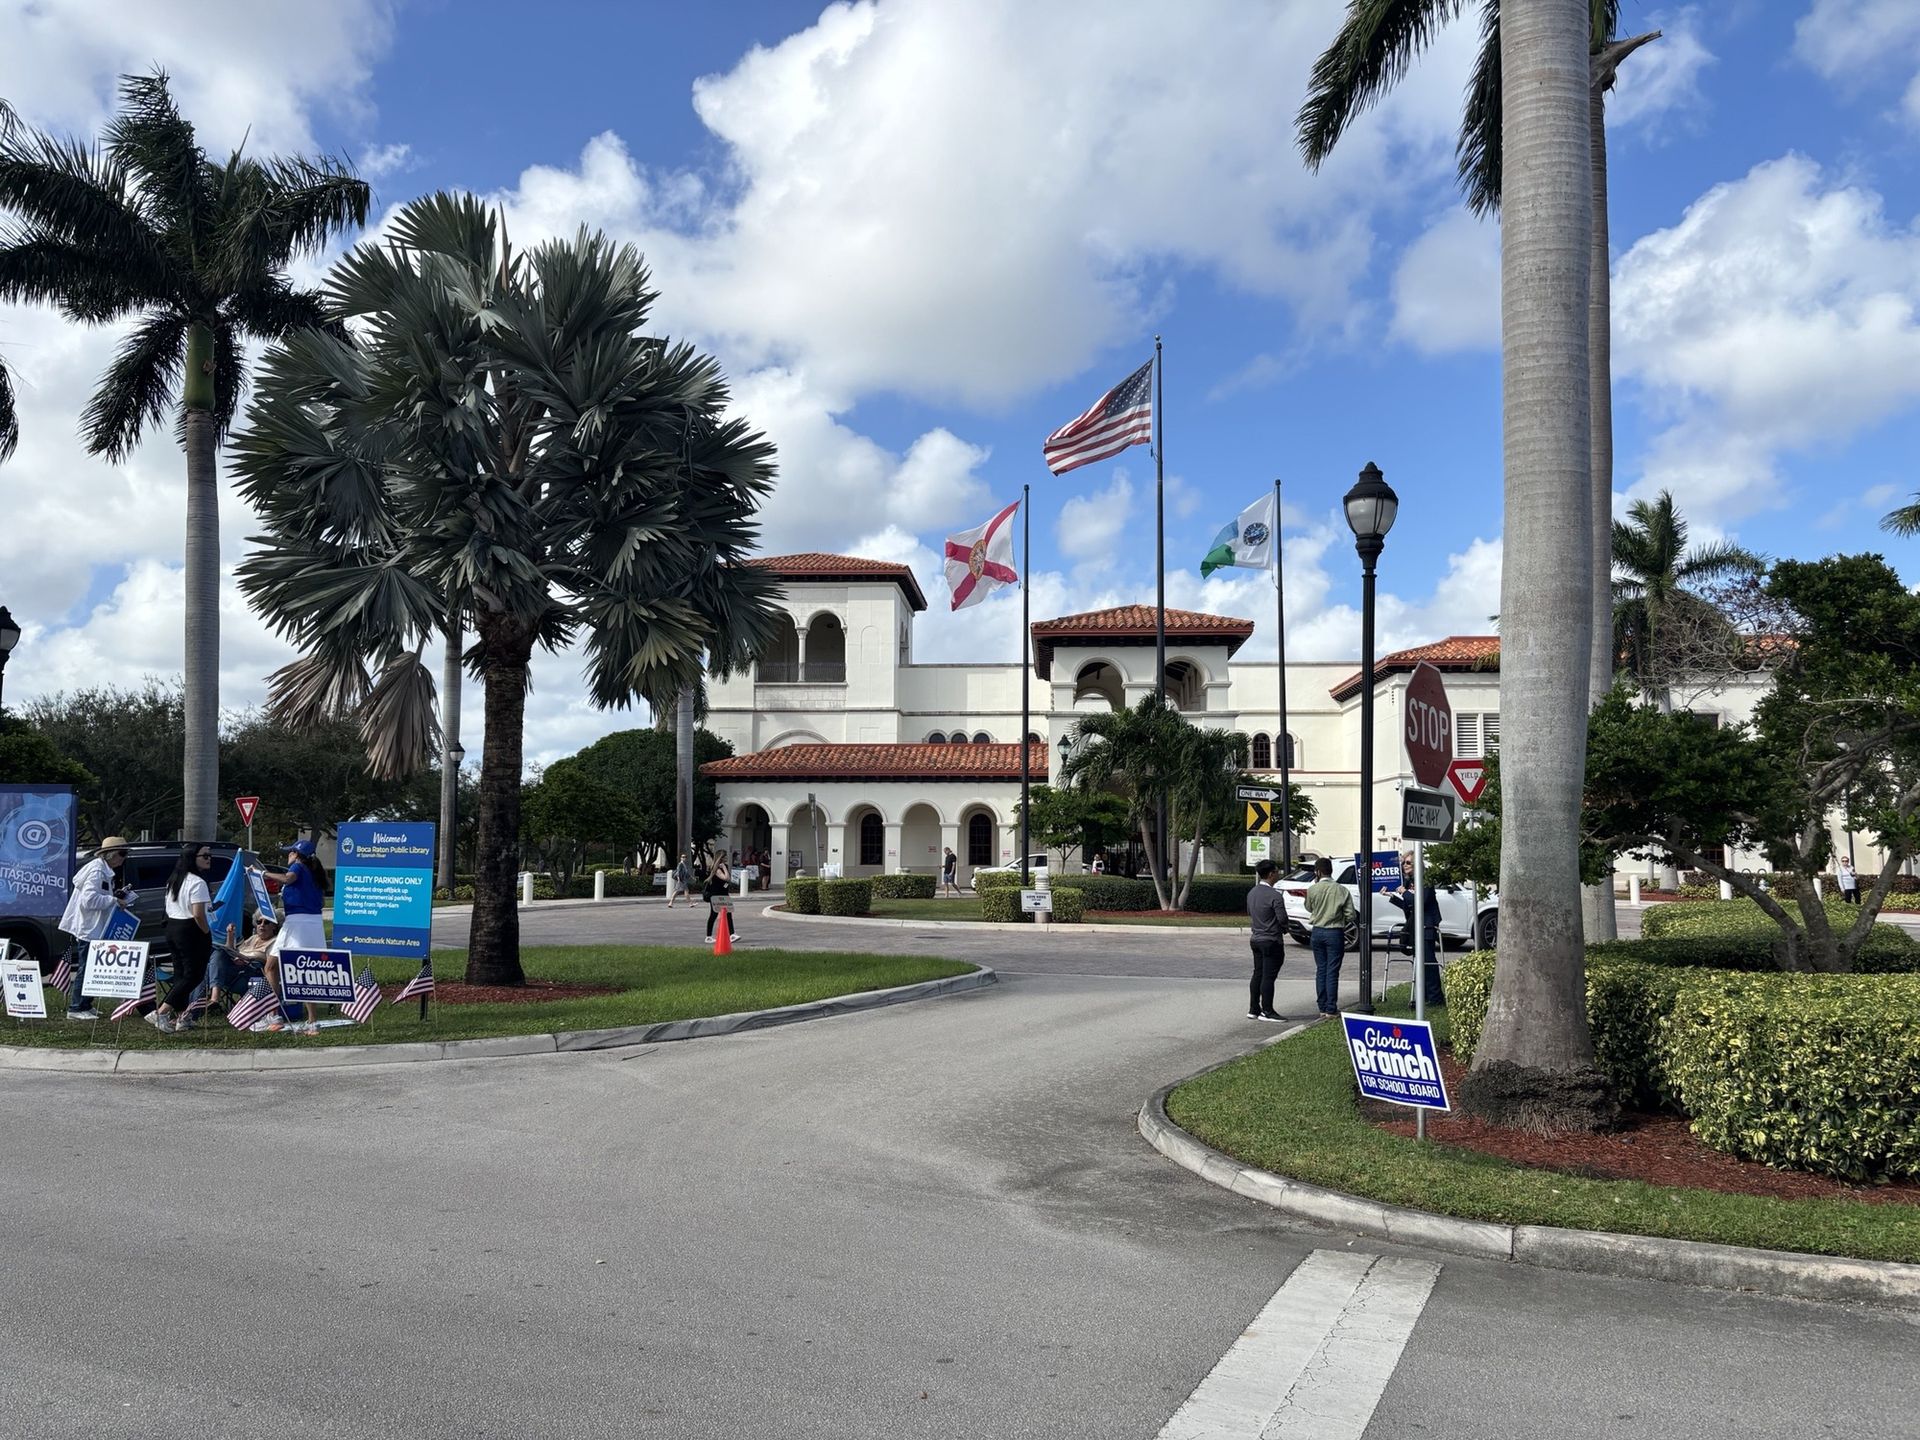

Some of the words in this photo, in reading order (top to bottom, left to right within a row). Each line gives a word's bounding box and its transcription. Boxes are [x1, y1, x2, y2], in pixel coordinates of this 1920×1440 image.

[1408, 697, 1449, 752] STOP
[1460, 771, 1479, 780] YIELD
[1408, 805, 1424, 825] ONE
[1425, 806, 1440, 827] WAY
[373, 832, 400, 844] Welcome
[400, 834, 408, 844] to
[390, 846, 408, 854] Public
[410, 847, 430, 856] Library
[344, 875, 372, 883] FACILITY
[374, 876, 404, 884] PARKING
[404, 877, 423, 885] ONLY
[92, 942, 105, 951] Vote
[354, 936, 385, 944] Pondhawk
[94, 950, 141, 968] KOCH
[296, 954, 334, 968] Gloria
[7, 974, 18, 982] VOTE
[18, 974, 33, 982] HERE
[284, 964, 350, 986] Branch
[287, 987, 300, 995] FOR
[302, 988, 328, 996] SCHOOL
[329, 989, 352, 997] BOARD
[1365, 1027, 1411, 1050] Gloria
[1352, 1038, 1436, 1081] Branch
[1362, 1075, 1378, 1089] FOR
[1377, 1078, 1409, 1095] SCHOOL
[1409, 1083, 1440, 1098] BOARD
